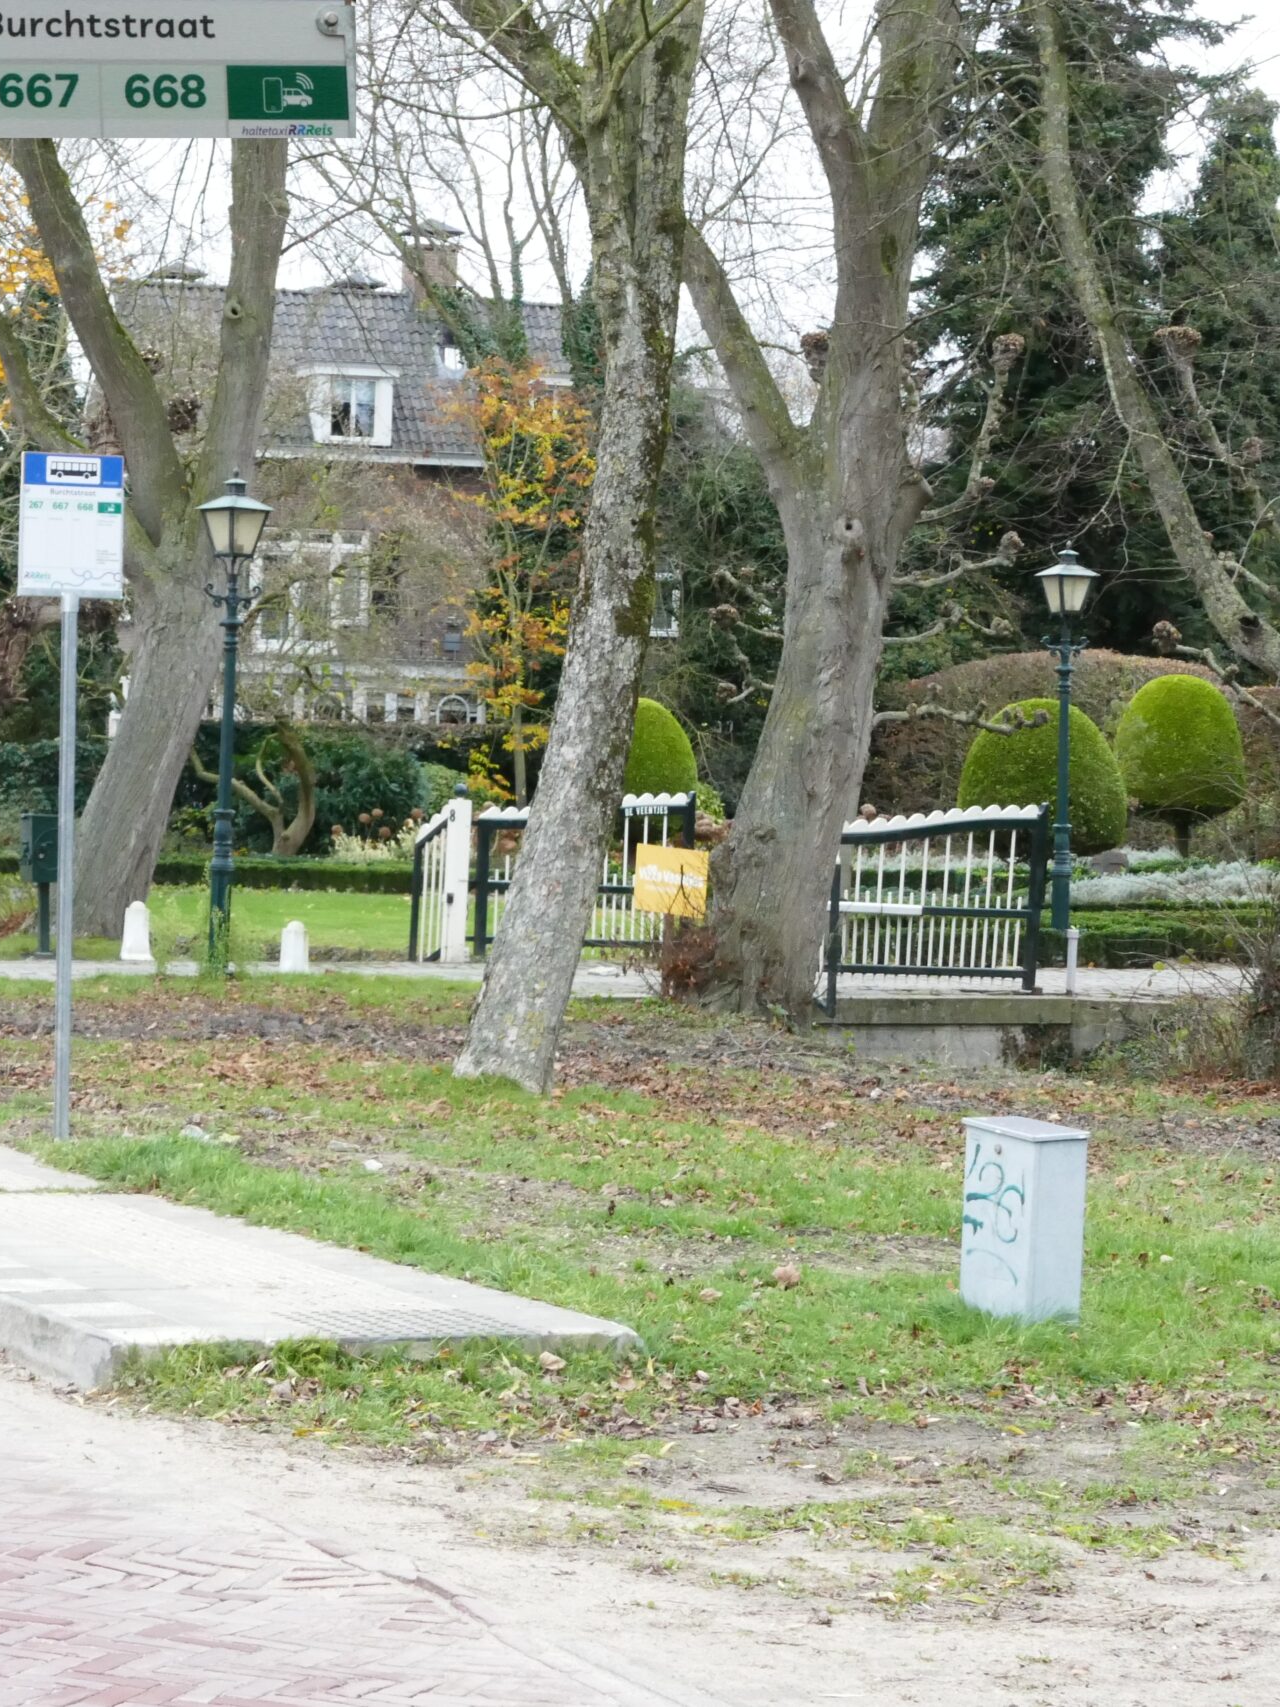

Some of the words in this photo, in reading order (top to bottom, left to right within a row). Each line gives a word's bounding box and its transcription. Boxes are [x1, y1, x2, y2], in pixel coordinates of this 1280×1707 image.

[124, 74, 207, 108] 668
[28, 501, 43, 509] 267
[52, 502, 69, 510] 667
[77, 503, 94, 511] 668
[449, 808, 456, 822] 8
